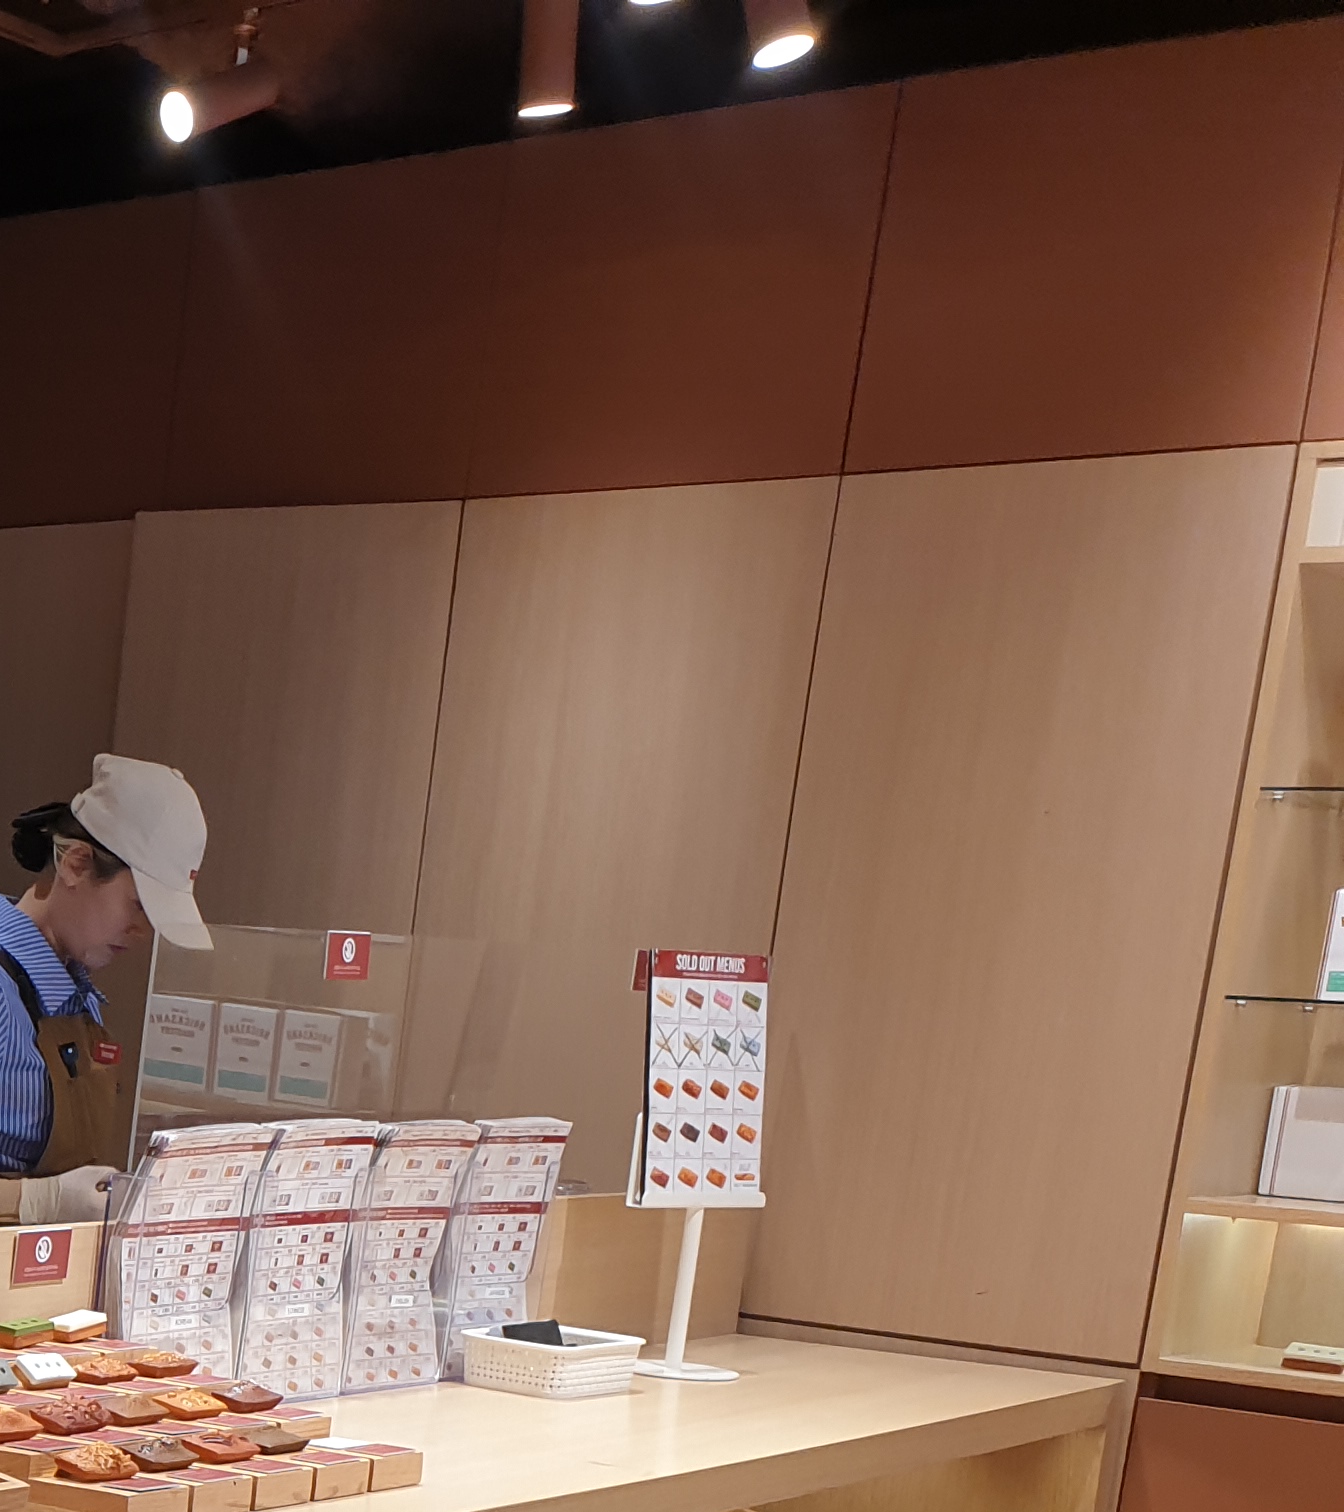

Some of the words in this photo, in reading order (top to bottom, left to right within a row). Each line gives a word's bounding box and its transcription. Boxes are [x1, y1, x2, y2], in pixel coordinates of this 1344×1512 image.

[675, 954, 698, 971] SOLD
[699, 956, 716, 972] OUT
[716, 957, 746, 974] MENUS
